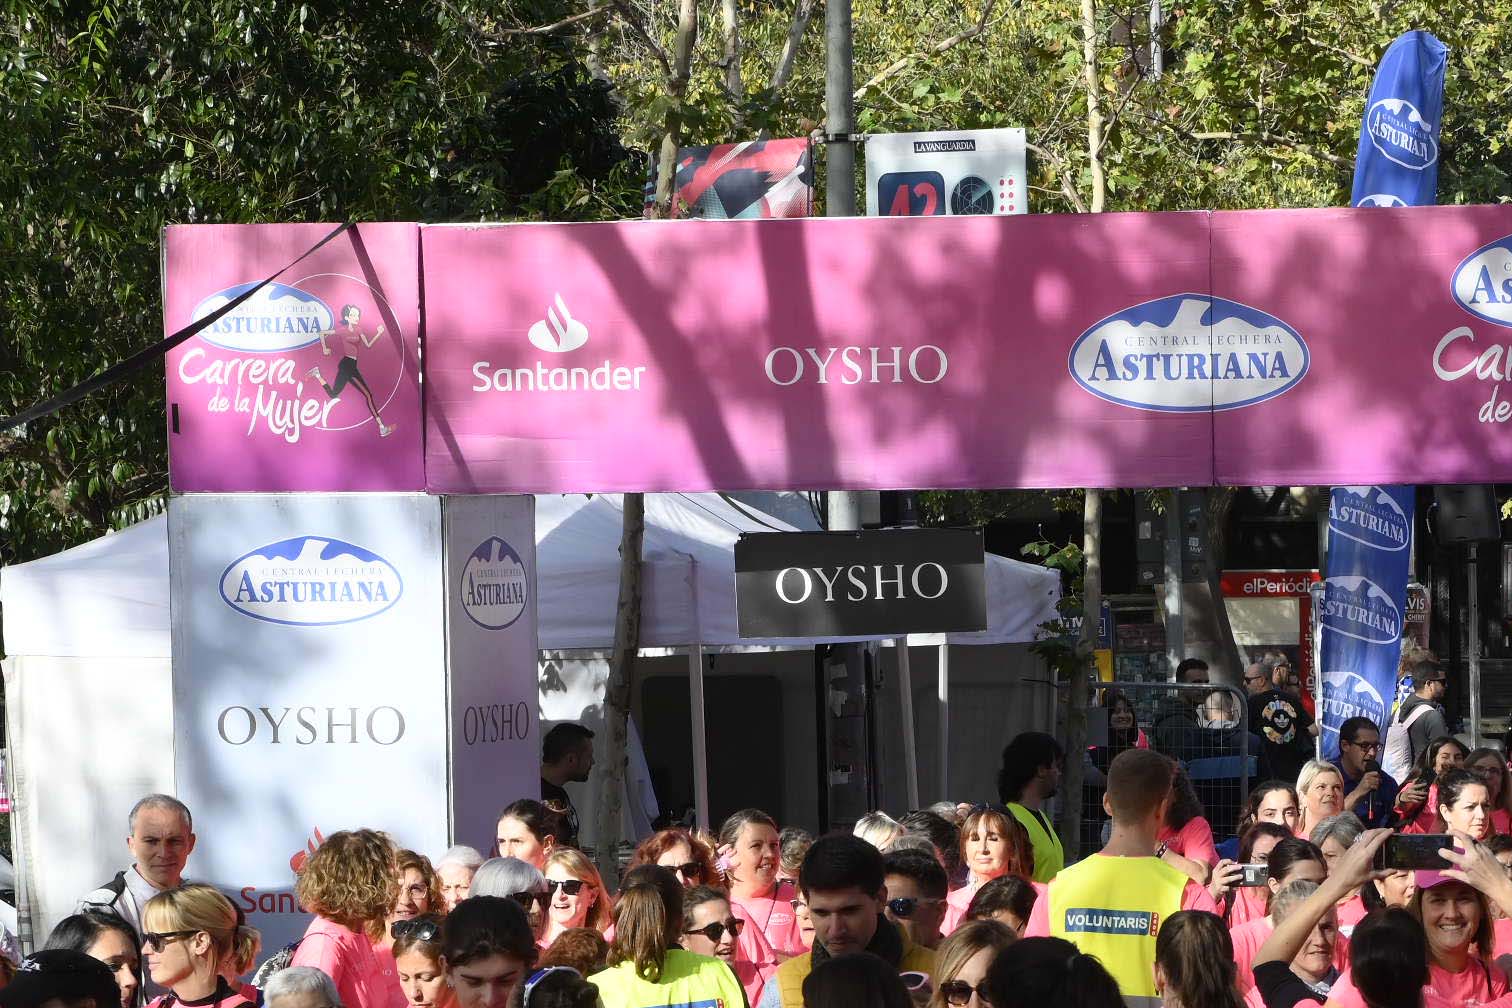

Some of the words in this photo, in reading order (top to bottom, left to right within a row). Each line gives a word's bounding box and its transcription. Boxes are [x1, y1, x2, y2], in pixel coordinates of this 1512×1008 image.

[925, 141, 975, 151] VANGUARDIA
[1371, 111, 1429, 161] ASTURIAN
[1124, 334, 1200, 347] CENTRAL
[1207, 333, 1283, 345] LECHERA
[178, 348, 297, 385] Carrera
[472, 359, 646, 393] Santander
[764, 344, 949, 386] OYSHO
[1088, 339, 1291, 382] ASTURIANA
[207, 386, 230, 413] de
[234, 384, 250, 413] la
[248, 382, 342, 444] Mujer
[1478, 386, 1512, 423] de
[1328, 495, 1405, 544] ASTURIANA
[235, 570, 390, 604] ASTURIANA
[261, 567, 319, 577] CENTRAL
[466, 572, 524, 607] ASTURIANA
[775, 561, 950, 605] OYSHO
[1243, 577, 1318, 593] elPeriódi
[1323, 600, 1396, 637] STURIANA
[217, 705, 406, 746] OYSHO
[463, 701, 530, 746] OYSHO
[1067, 914, 1148, 929] VOLUNTARIS
